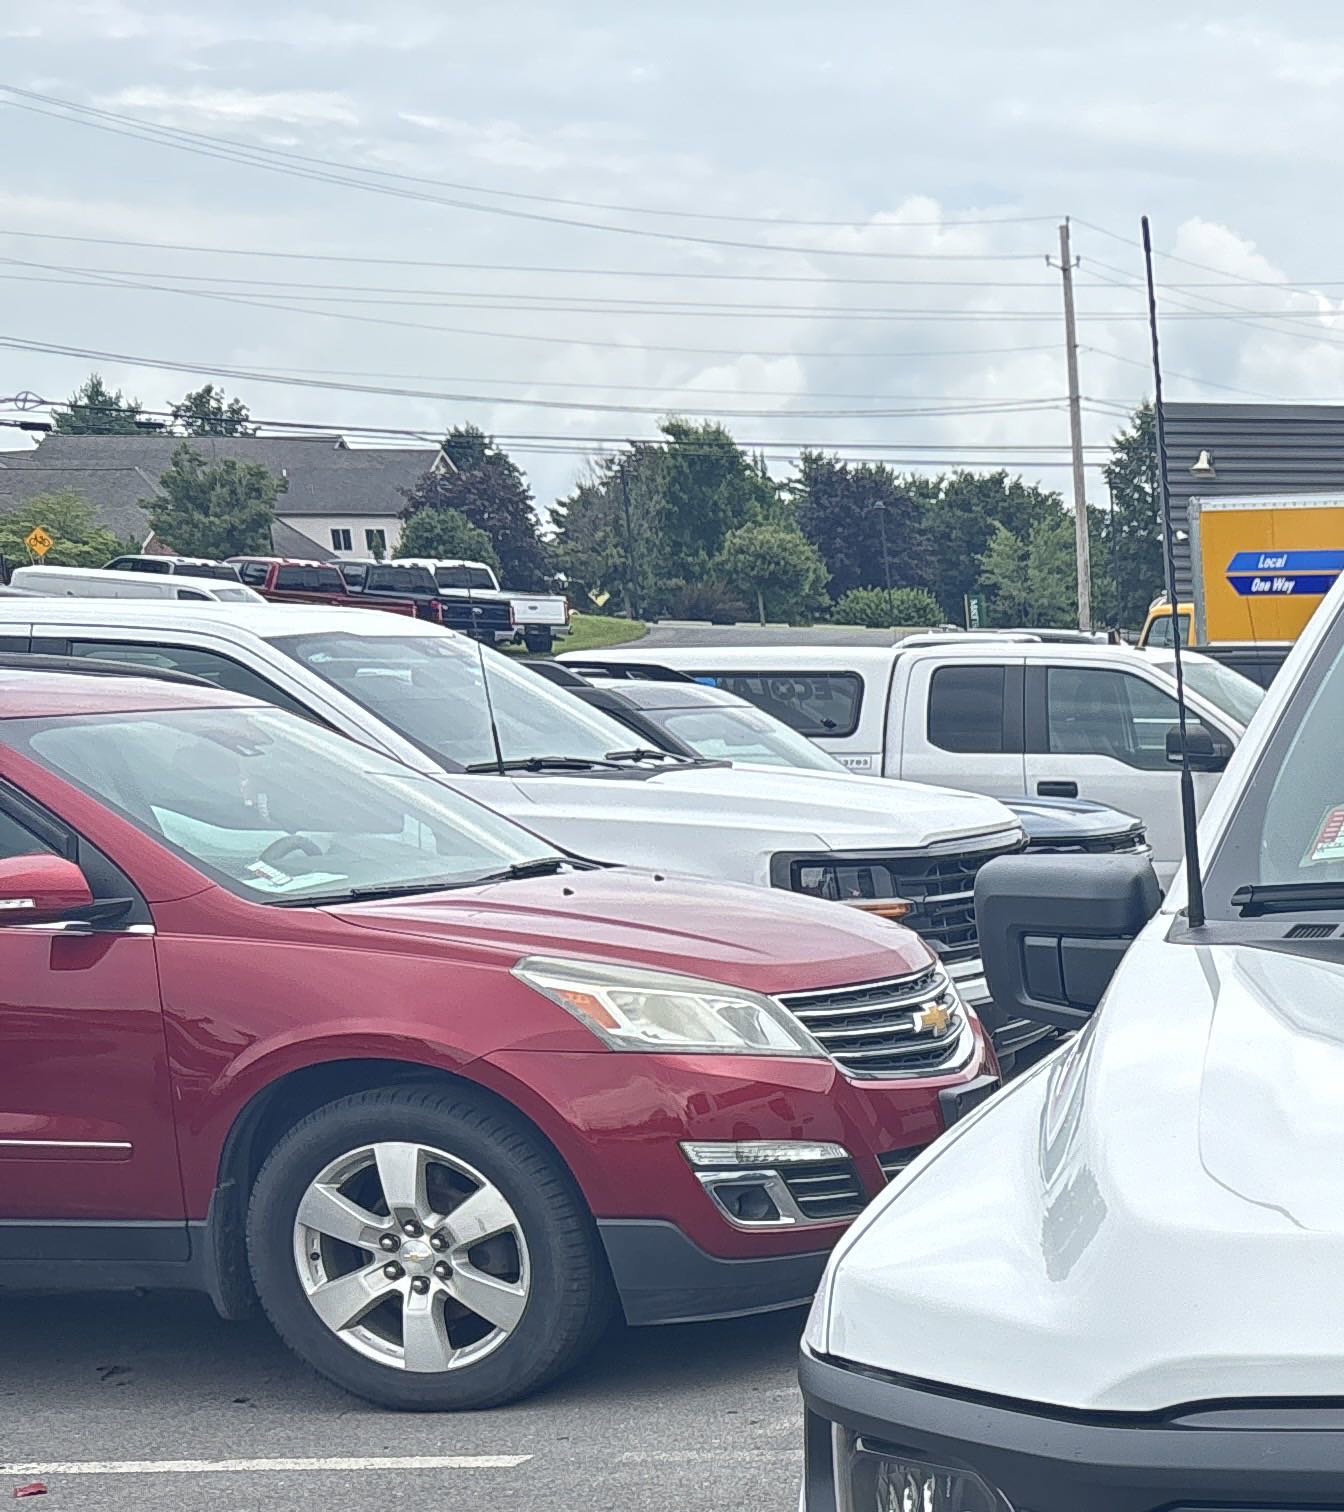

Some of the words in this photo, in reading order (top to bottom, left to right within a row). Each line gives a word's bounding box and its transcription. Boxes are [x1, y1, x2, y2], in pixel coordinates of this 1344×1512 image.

[1258, 553, 1287, 569] Local
[1251, 577, 1271, 593] One
[1272, 577, 1296, 594] Way
